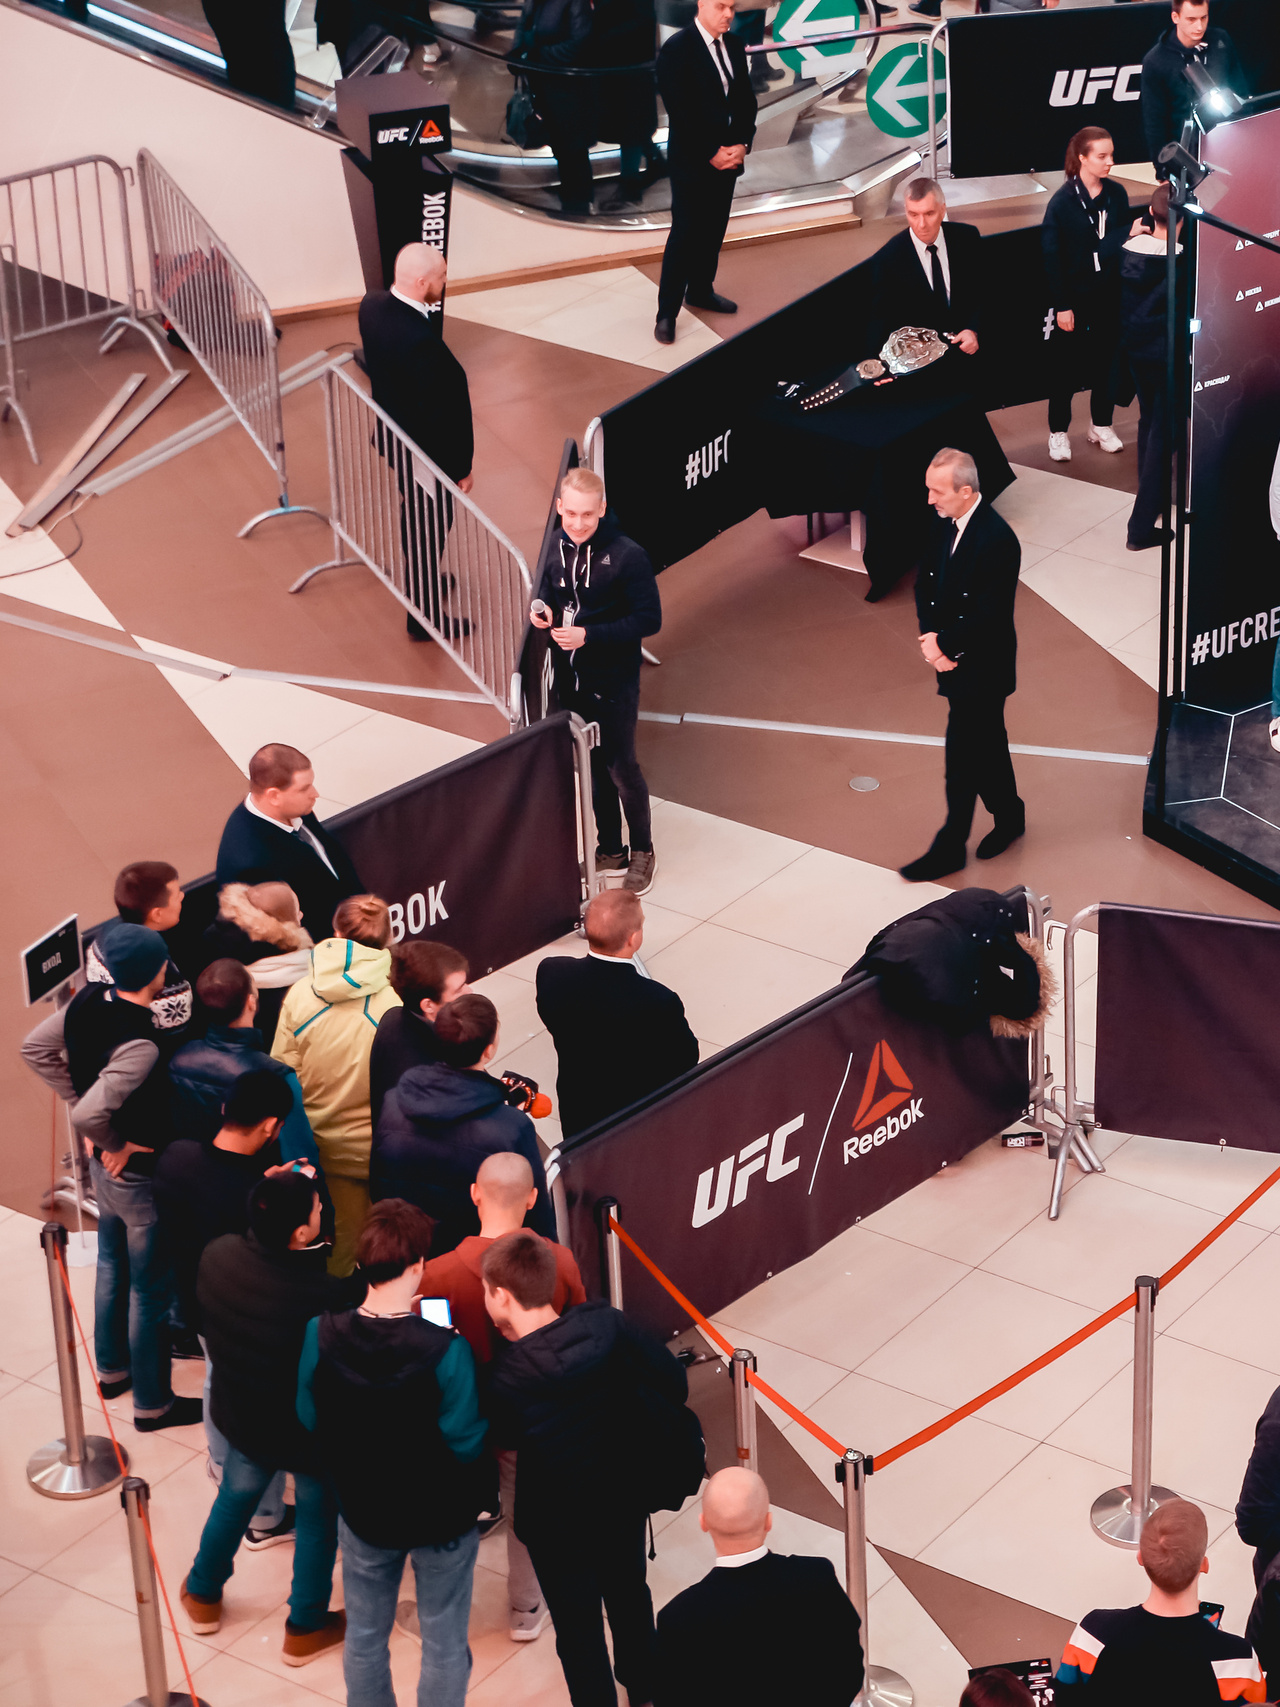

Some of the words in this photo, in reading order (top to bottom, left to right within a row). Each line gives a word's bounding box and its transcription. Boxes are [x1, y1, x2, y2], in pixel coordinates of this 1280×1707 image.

[1049, 64, 1143, 107] UFC
[377, 127, 410, 144] UFC
[387, 879, 450, 945] BOK
[41, 951, 62, 974] ВХОД
[843, 1097, 925, 1166] Reebok
[692, 1112, 805, 1229] UFC
